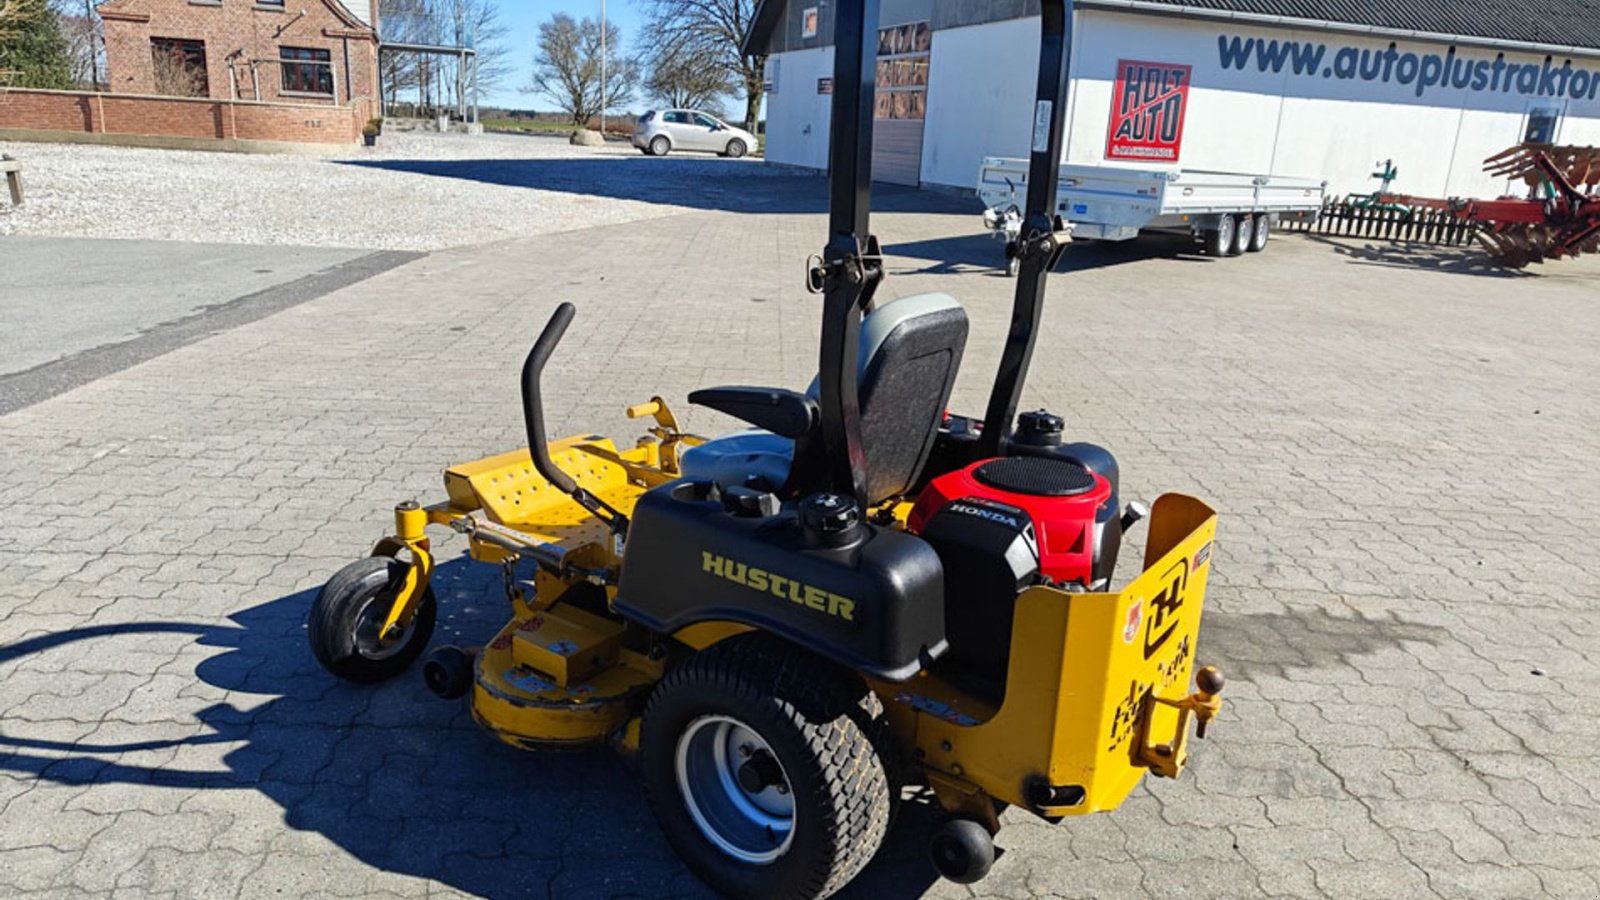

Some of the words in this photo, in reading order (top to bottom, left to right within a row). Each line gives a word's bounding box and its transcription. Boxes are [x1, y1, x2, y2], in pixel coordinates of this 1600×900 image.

[1121, 65, 1185, 115] HOLT
[1218, 34, 1600, 100] www.autoplustraktor
[1114, 92, 1182, 142] AUTO
[950, 504, 1018, 527] HONDA
[702, 550, 856, 621] HUSTLER
